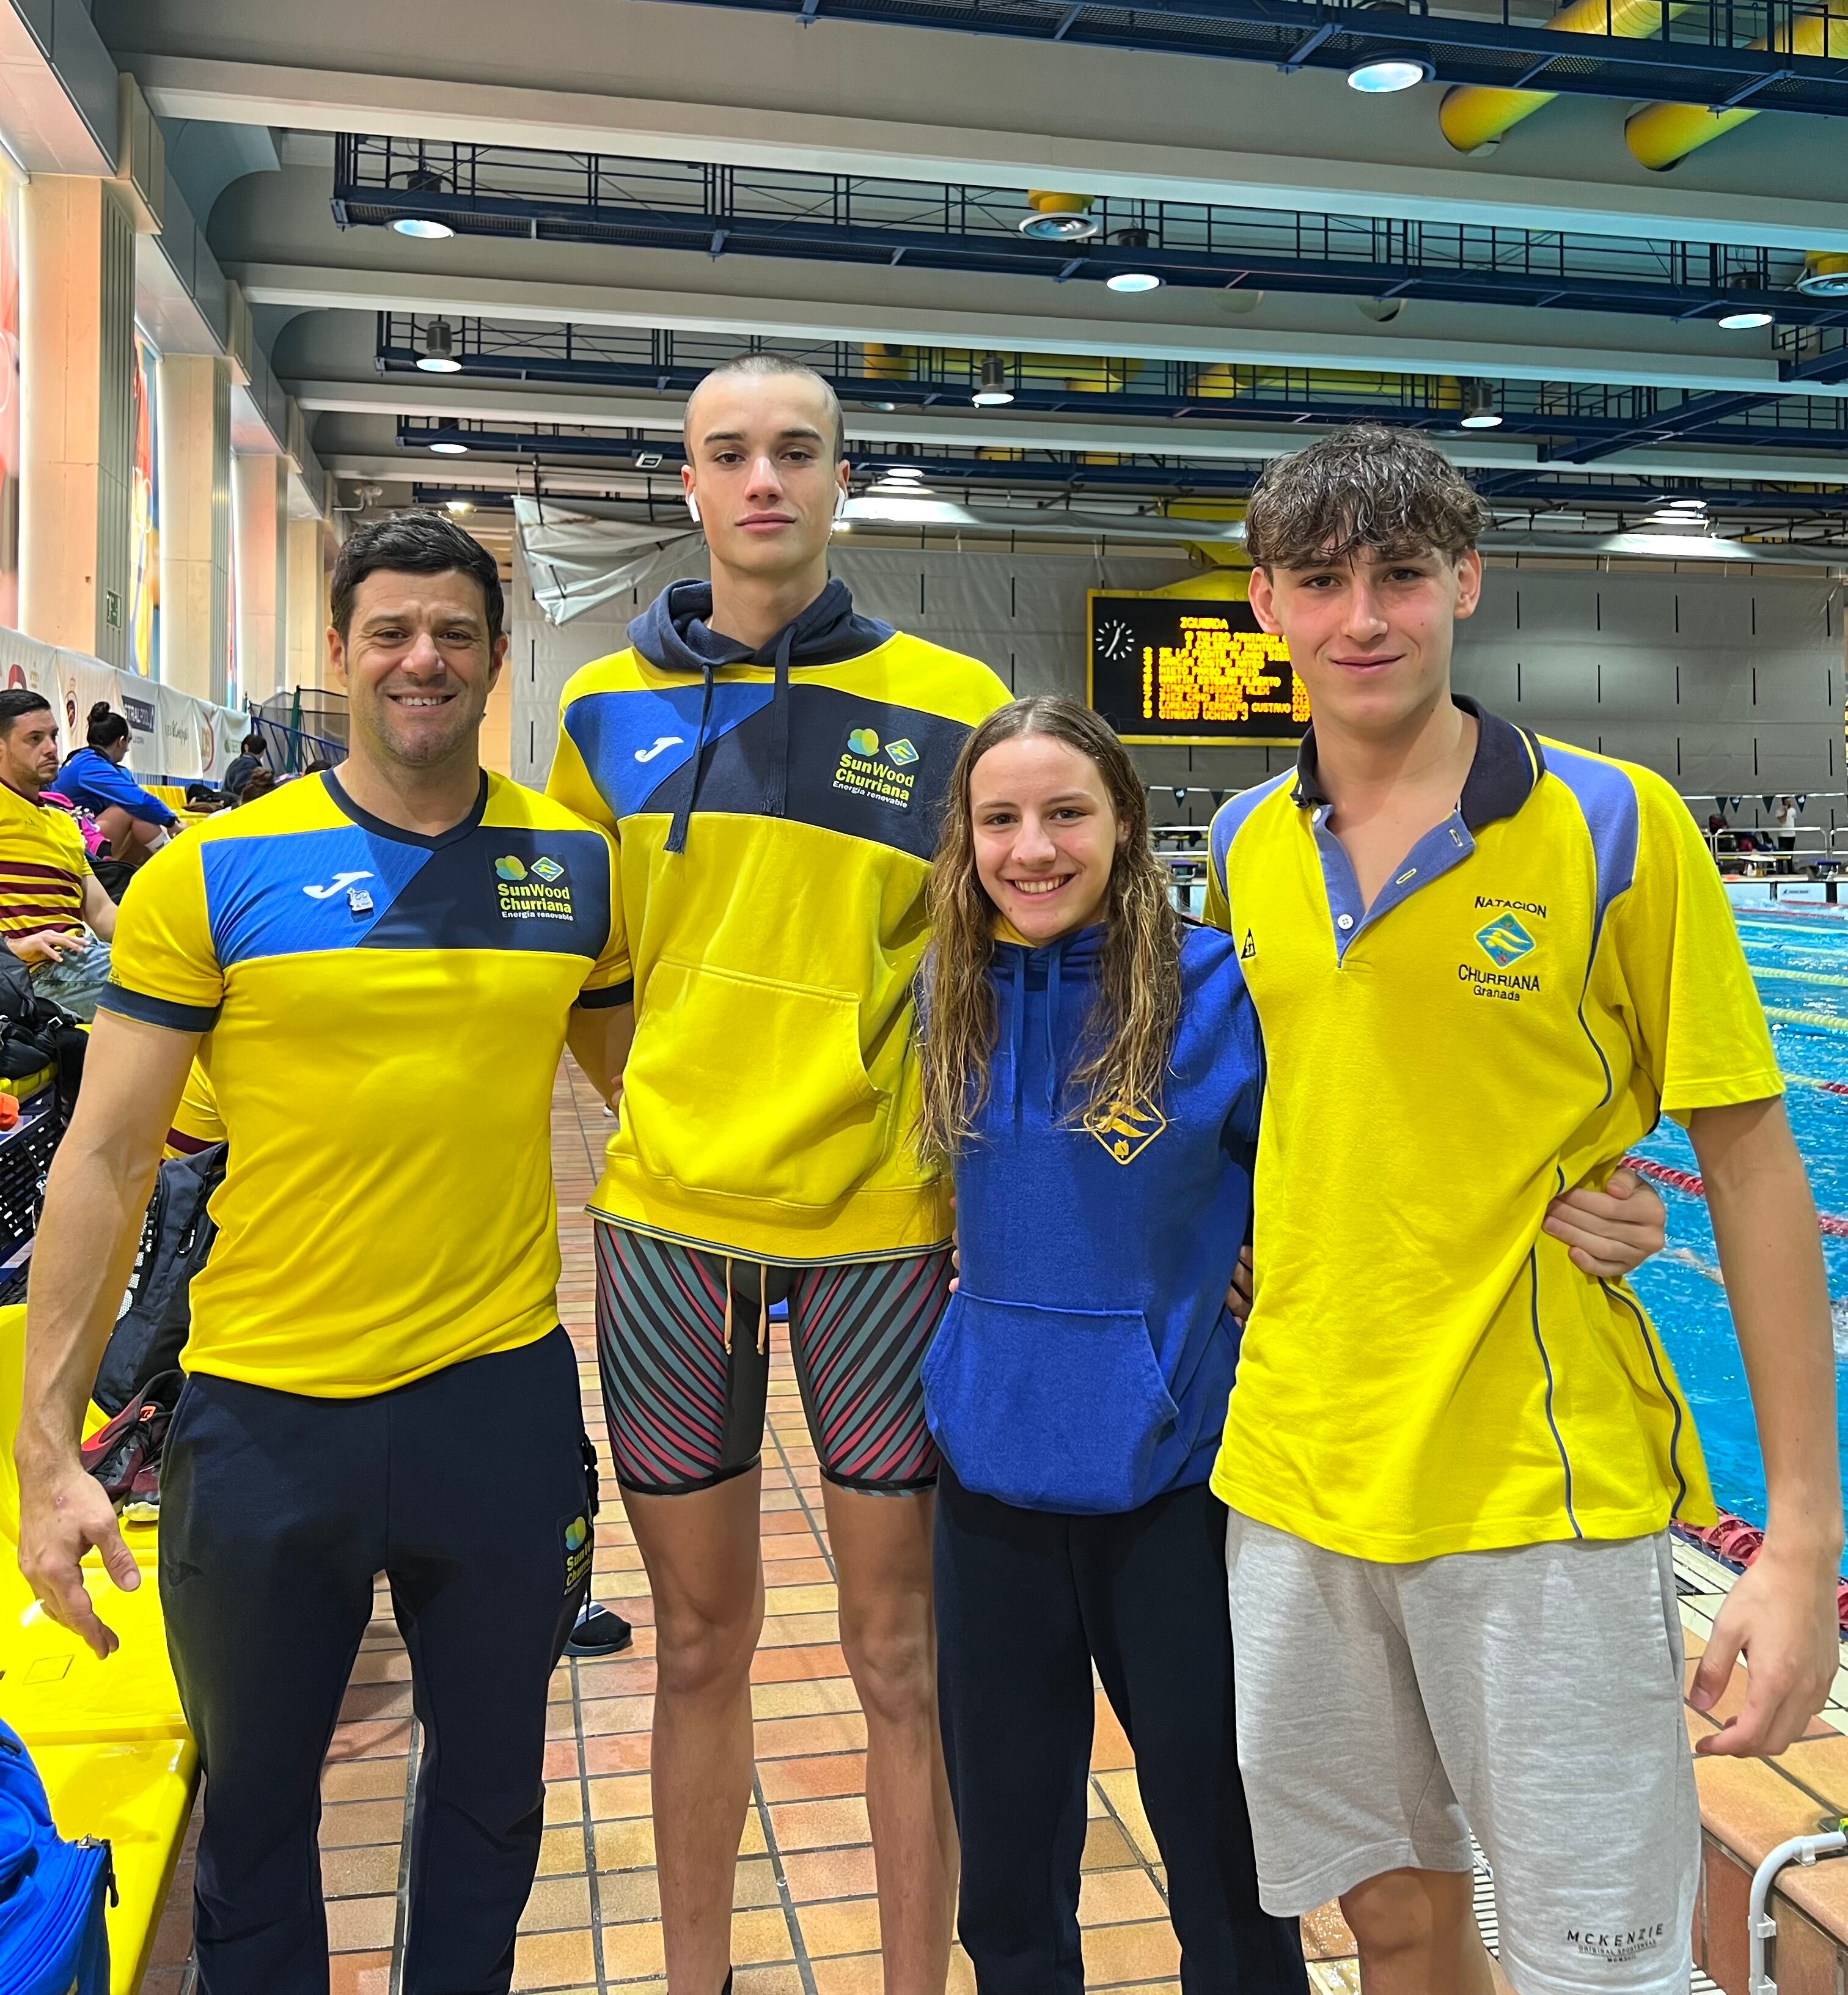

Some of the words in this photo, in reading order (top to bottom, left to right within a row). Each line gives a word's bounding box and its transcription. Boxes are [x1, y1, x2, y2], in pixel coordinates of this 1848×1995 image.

[840, 754, 915, 788] SunWood
[835, 768, 910, 801] Churriana
[867, 791, 908, 809] renovable
[497, 883, 570, 900] SunWood
[500, 897, 572, 913] Churriana
[537, 911, 573, 921] renovable
[1458, 964, 1541, 991] CHURRIANA
[1473, 985, 1520, 1001] Granada
[1567, 1923, 1663, 1947] MCKENZIE
